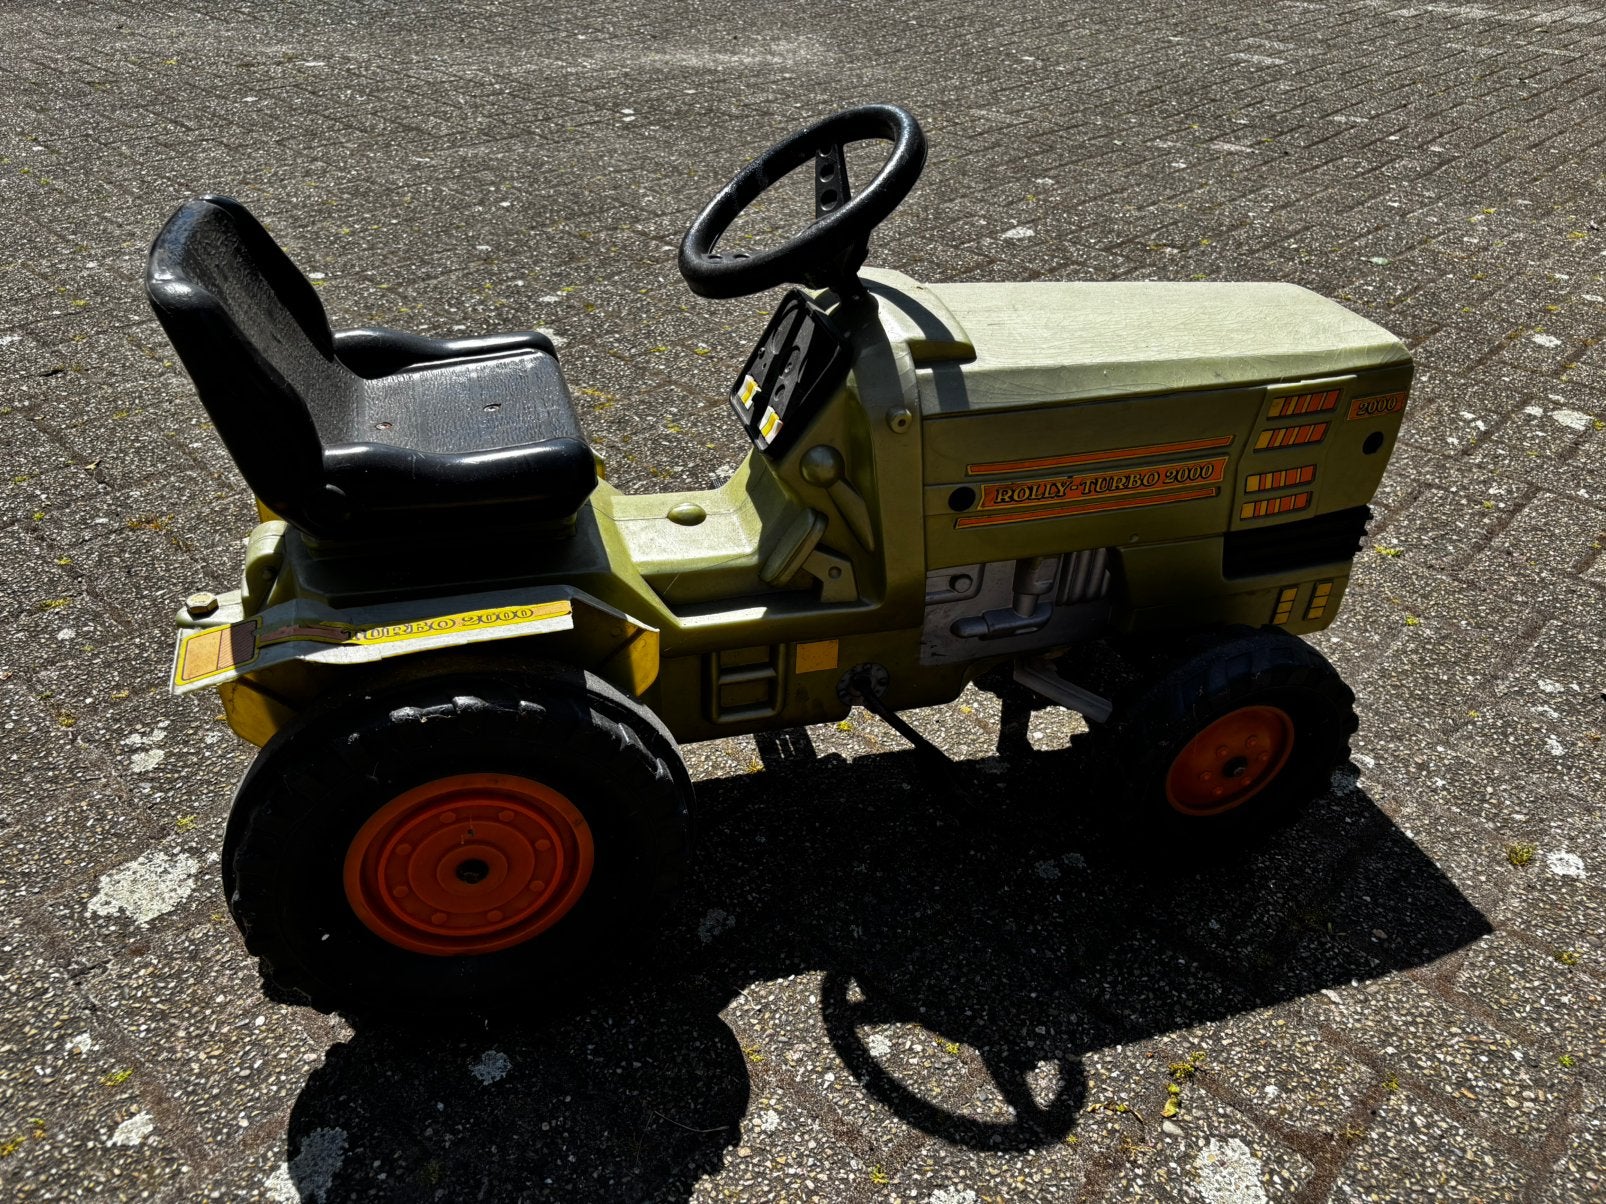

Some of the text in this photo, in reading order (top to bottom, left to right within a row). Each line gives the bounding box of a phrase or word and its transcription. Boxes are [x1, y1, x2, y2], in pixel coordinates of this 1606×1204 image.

[1357, 397, 1397, 416] 2000
[1163, 463, 1214, 485] 2000
[461, 607, 534, 626] 2000
